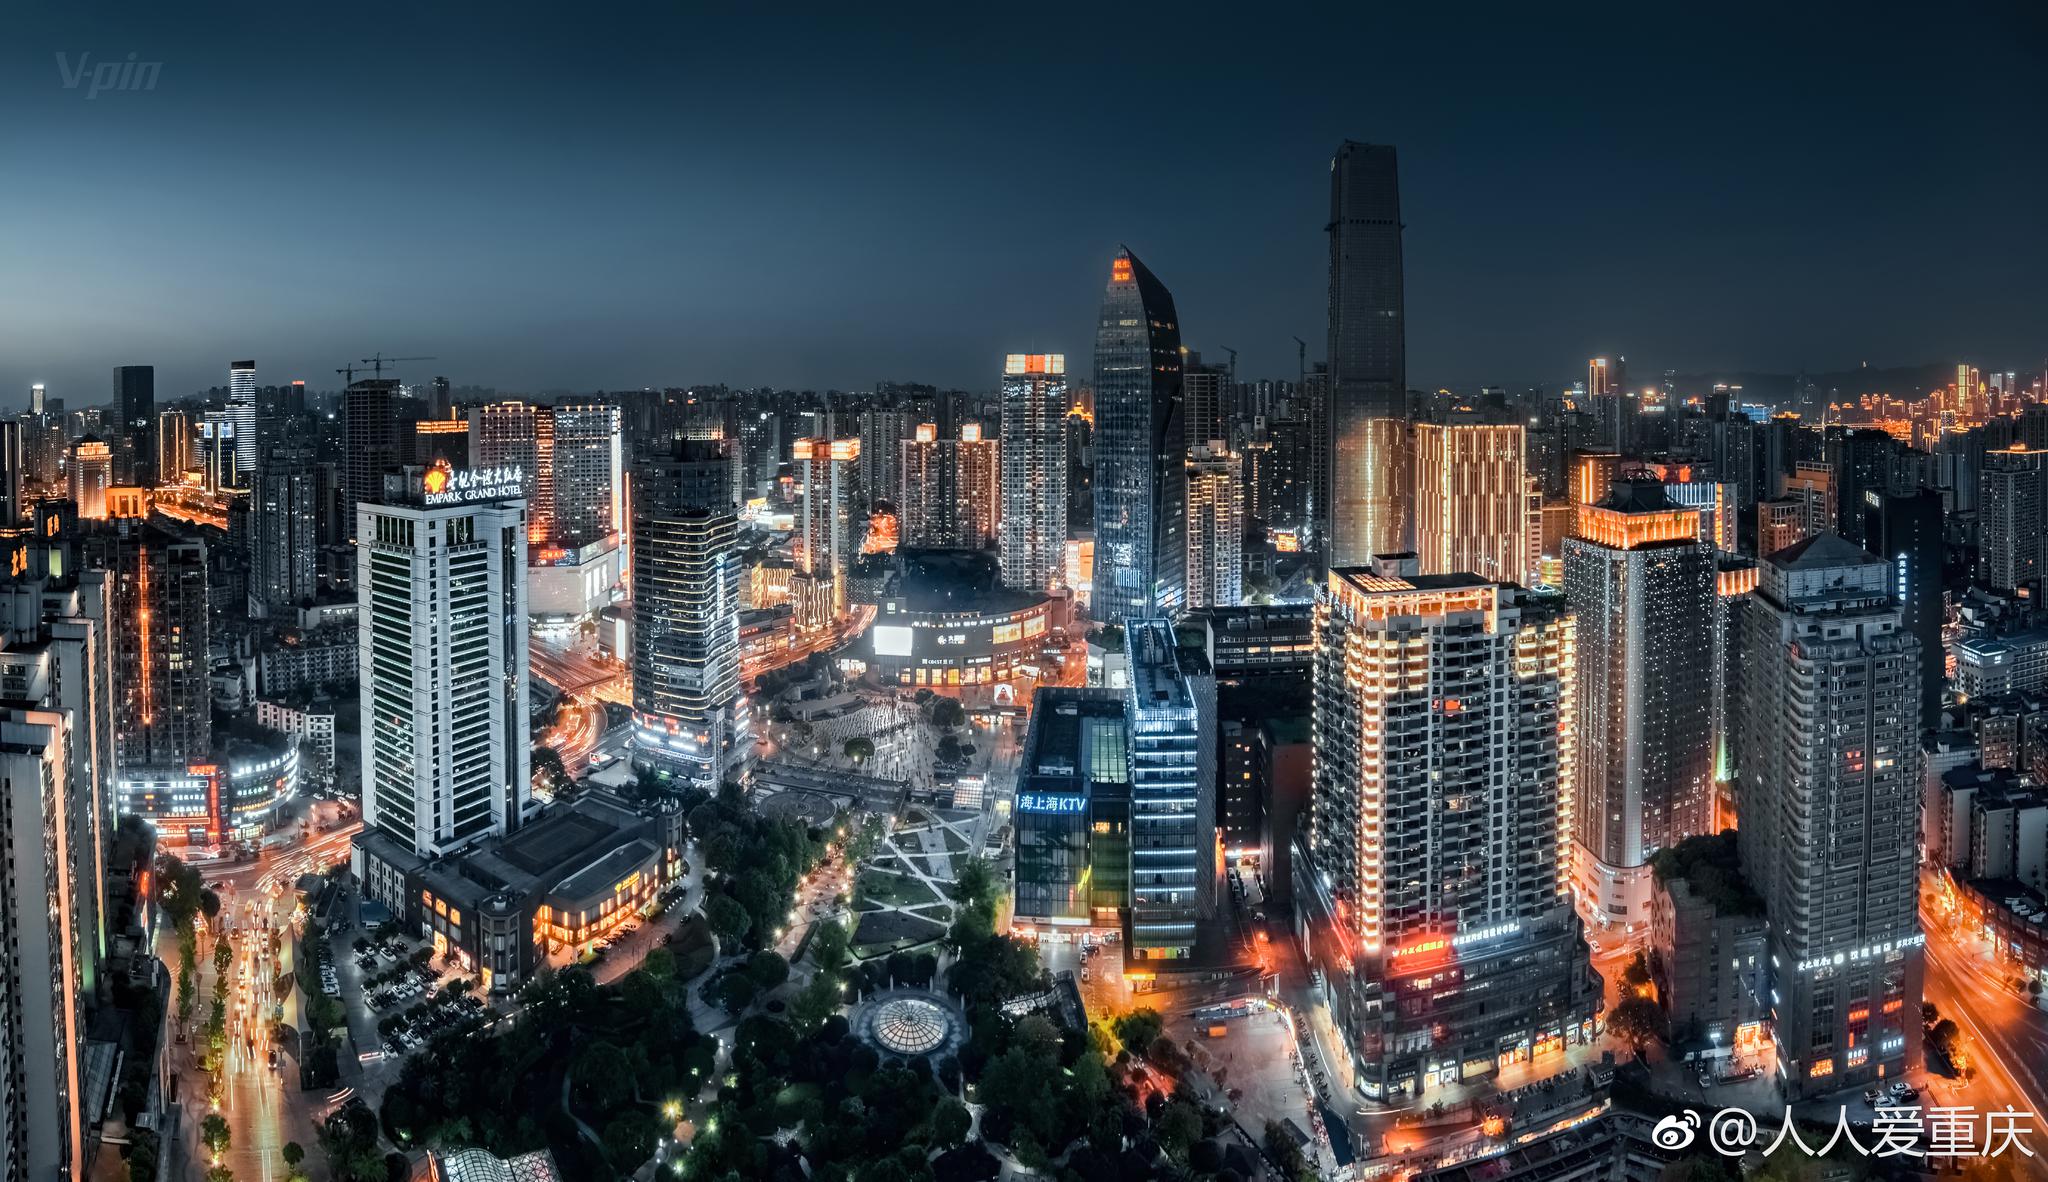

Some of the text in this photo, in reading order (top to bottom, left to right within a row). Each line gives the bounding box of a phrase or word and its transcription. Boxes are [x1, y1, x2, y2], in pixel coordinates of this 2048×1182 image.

[425, 484, 523, 505] EMPARK GRAND HOTEL
